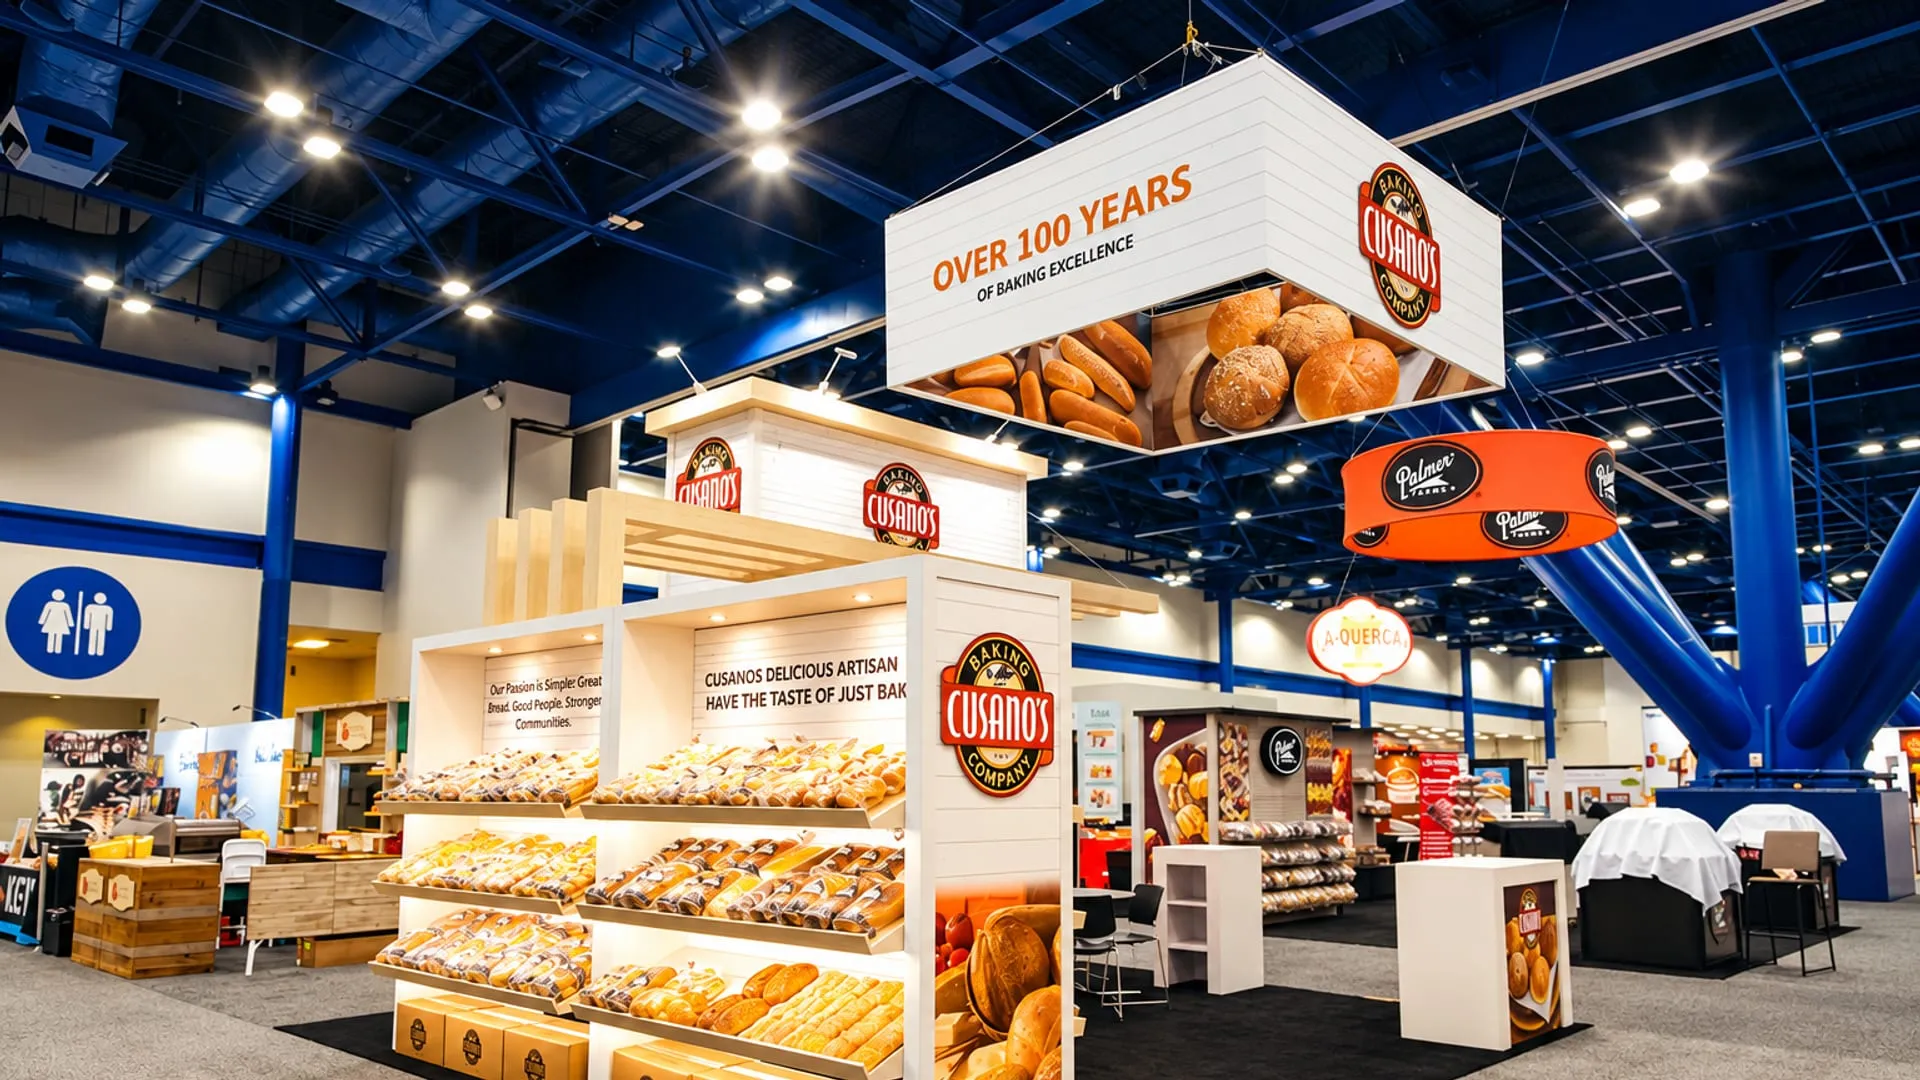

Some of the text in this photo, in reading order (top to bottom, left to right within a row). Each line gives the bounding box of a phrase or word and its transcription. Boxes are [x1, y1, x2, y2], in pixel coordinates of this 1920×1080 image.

[1379, 175, 1423, 219] BAKING
[933, 164, 1193, 292] OVER 100 YEARS
[1363, 205, 1437, 289] CUSANO'S
[977, 233, 1134, 302] OF BAKING EXCELLENCE
[1379, 273, 1425, 320] COMPANY
[867, 493, 937, 538] CUSANO'S
[705, 655, 898, 688] CUSANOS DELICIOUS ARTISAN
[969, 643, 1031, 678] BAKING
[490, 684, 504, 696] Our
[506, 681, 535, 695] Passion
[536, 680, 543, 691] is
[577, 675, 602, 688] Great
[512, 700, 533, 712] Good
[565, 696, 602, 709] Stronger
[706, 682, 907, 711] HAVE THE TASTE OF JUST BAK
[515, 716, 572, 730] Communities.
[947, 690, 1050, 744] CUSANO'S
[967, 752, 1032, 788] COMPANY
